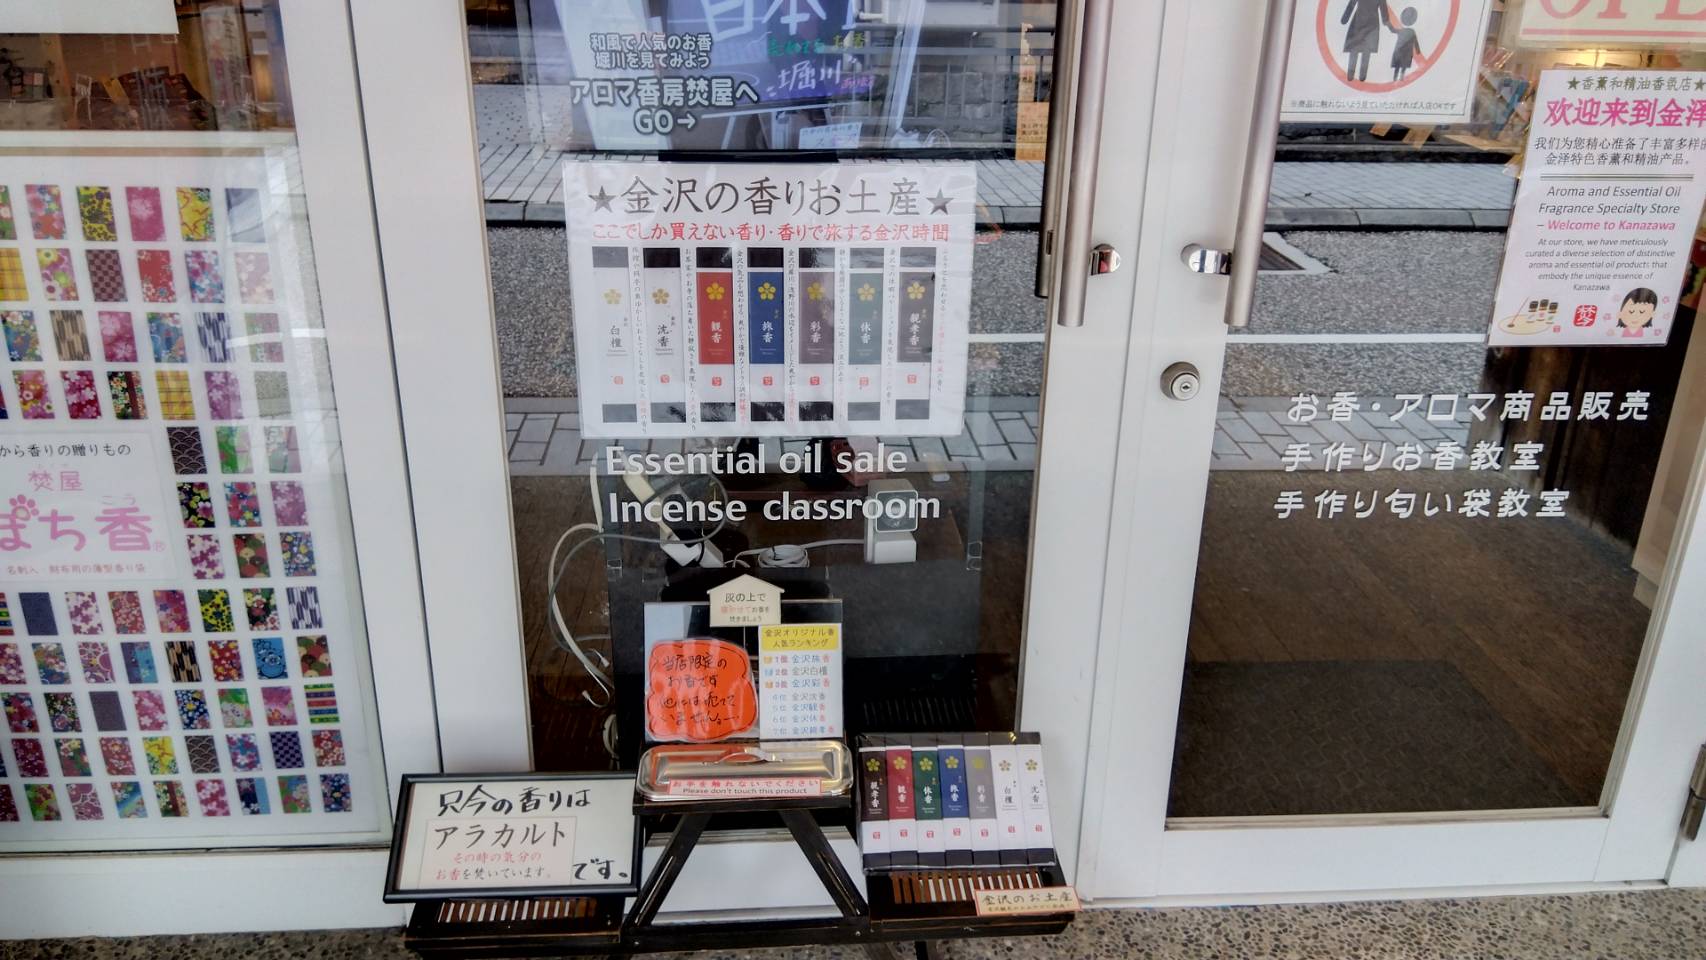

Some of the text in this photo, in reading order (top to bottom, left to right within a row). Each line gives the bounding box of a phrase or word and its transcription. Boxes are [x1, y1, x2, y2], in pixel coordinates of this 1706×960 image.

[589, 33, 712, 52] 和風で人気のお香
[595, 51, 711, 69] 堀川を見てみよう
[778, 59, 842, 91] 堀川
[569, 77, 759, 107] アロマ香房焚屋へ
[634, 109, 674, 134] GO
[620, 175, 921, 217] 金沢の香りお土産
[1546, 186, 1682, 197] Aroma and Essential Oil
[1538, 203, 1680, 215] Fragrance Specialty Store
[592, 222, 950, 242] ここでしか買えない香り・香りで旅する金沢時間
[1547, 220, 1676, 231] Welcome to Kanazawa
[1538, 238, 1547, 246] At
[1561, 239, 1584, 247] store,
[1600, 238, 1619, 246] have
[1620, 238, 1668, 247] meticulously
[1525, 250, 1554, 258] curated
[1562, 250, 1589, 258] diverse
[1591, 250, 1626, 258] selection
[1627, 250, 1635, 258] of
[1636, 250, 1676, 258] distinctive
[1554, 261, 1569, 269] and
[1570, 261, 1604, 269] essential
[1605, 261, 1615, 269] oil
[1616, 261, 1650, 270] products
[1651, 261, 1668, 269] that
[1538, 272, 1569, 281] embody
[1571, 272, 1583, 280] the
[1585, 273, 1611, 281] unique
[1644, 272, 1653, 280] of
[1286, 390, 1651, 423] お香・アロマ商品販売
[606, 440, 908, 475] Essential oil sale
[1280, 440, 1545, 473] 手作りお香教室
[28, 470, 84, 492] 焚屋
[609, 490, 941, 523] Incense classroom
[1273, 488, 1570, 519] 手作り匂い袋教室
[725, 591, 766, 603] 灰の上で
[673, 779, 819, 787] お手を触れないでください
[710, 787, 732, 795] don't
[734, 787, 757, 795] touch
[759, 787, 774, 795] this
[775, 788, 807, 796] product
[438, 784, 591, 817] 只今の香りは
[435, 821, 566, 850] アラカルト
[436, 866, 551, 881] お香を焚いています。
[572, 858, 629, 881] です。
